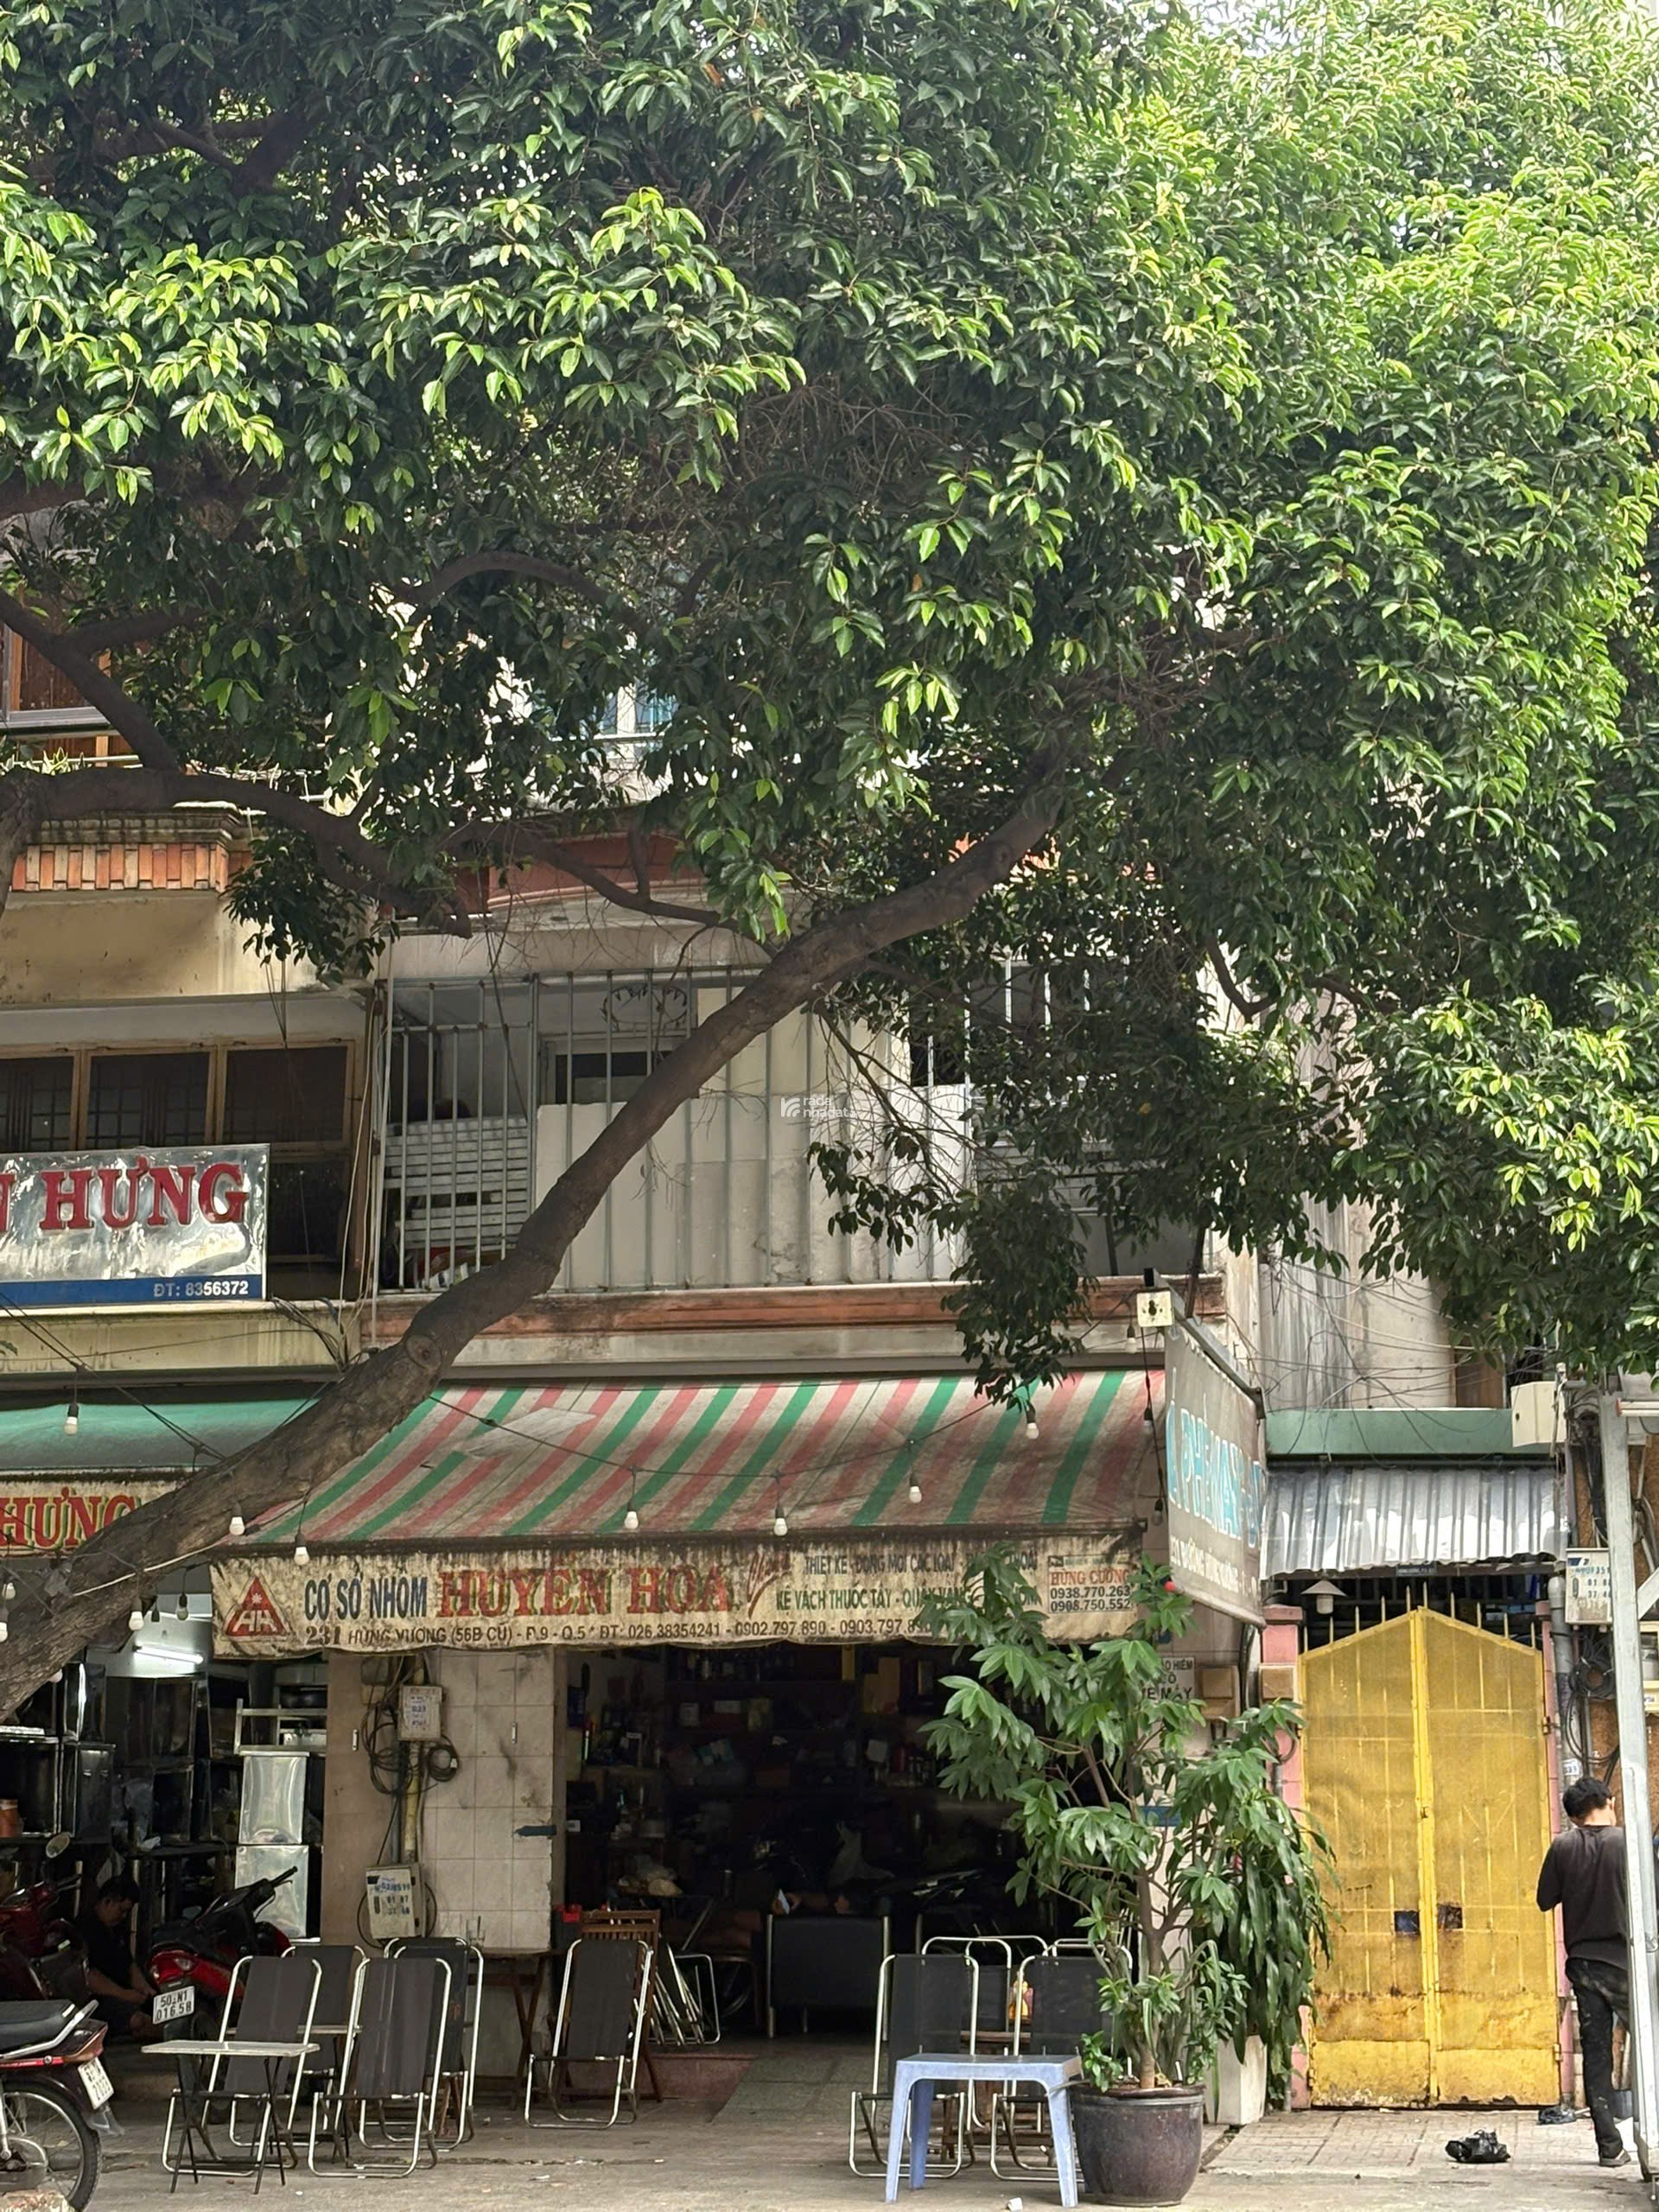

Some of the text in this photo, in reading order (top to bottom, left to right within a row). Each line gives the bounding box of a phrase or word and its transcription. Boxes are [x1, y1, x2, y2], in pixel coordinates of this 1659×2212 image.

[39, 1154, 249, 1230] HƯNG
[186, 1281, 248, 1297] 8356372
[794, 1585, 826, 1611] VÁCH
[1050, 1586, 1131, 1599] 0938.770.263
[1050, 1598, 1131, 1612] 0908.750.552
[306, 1625, 341, 1645] 231
[452, 1626, 482, 1644] (56B
[735, 1620, 826, 1637] 0902.797.890
